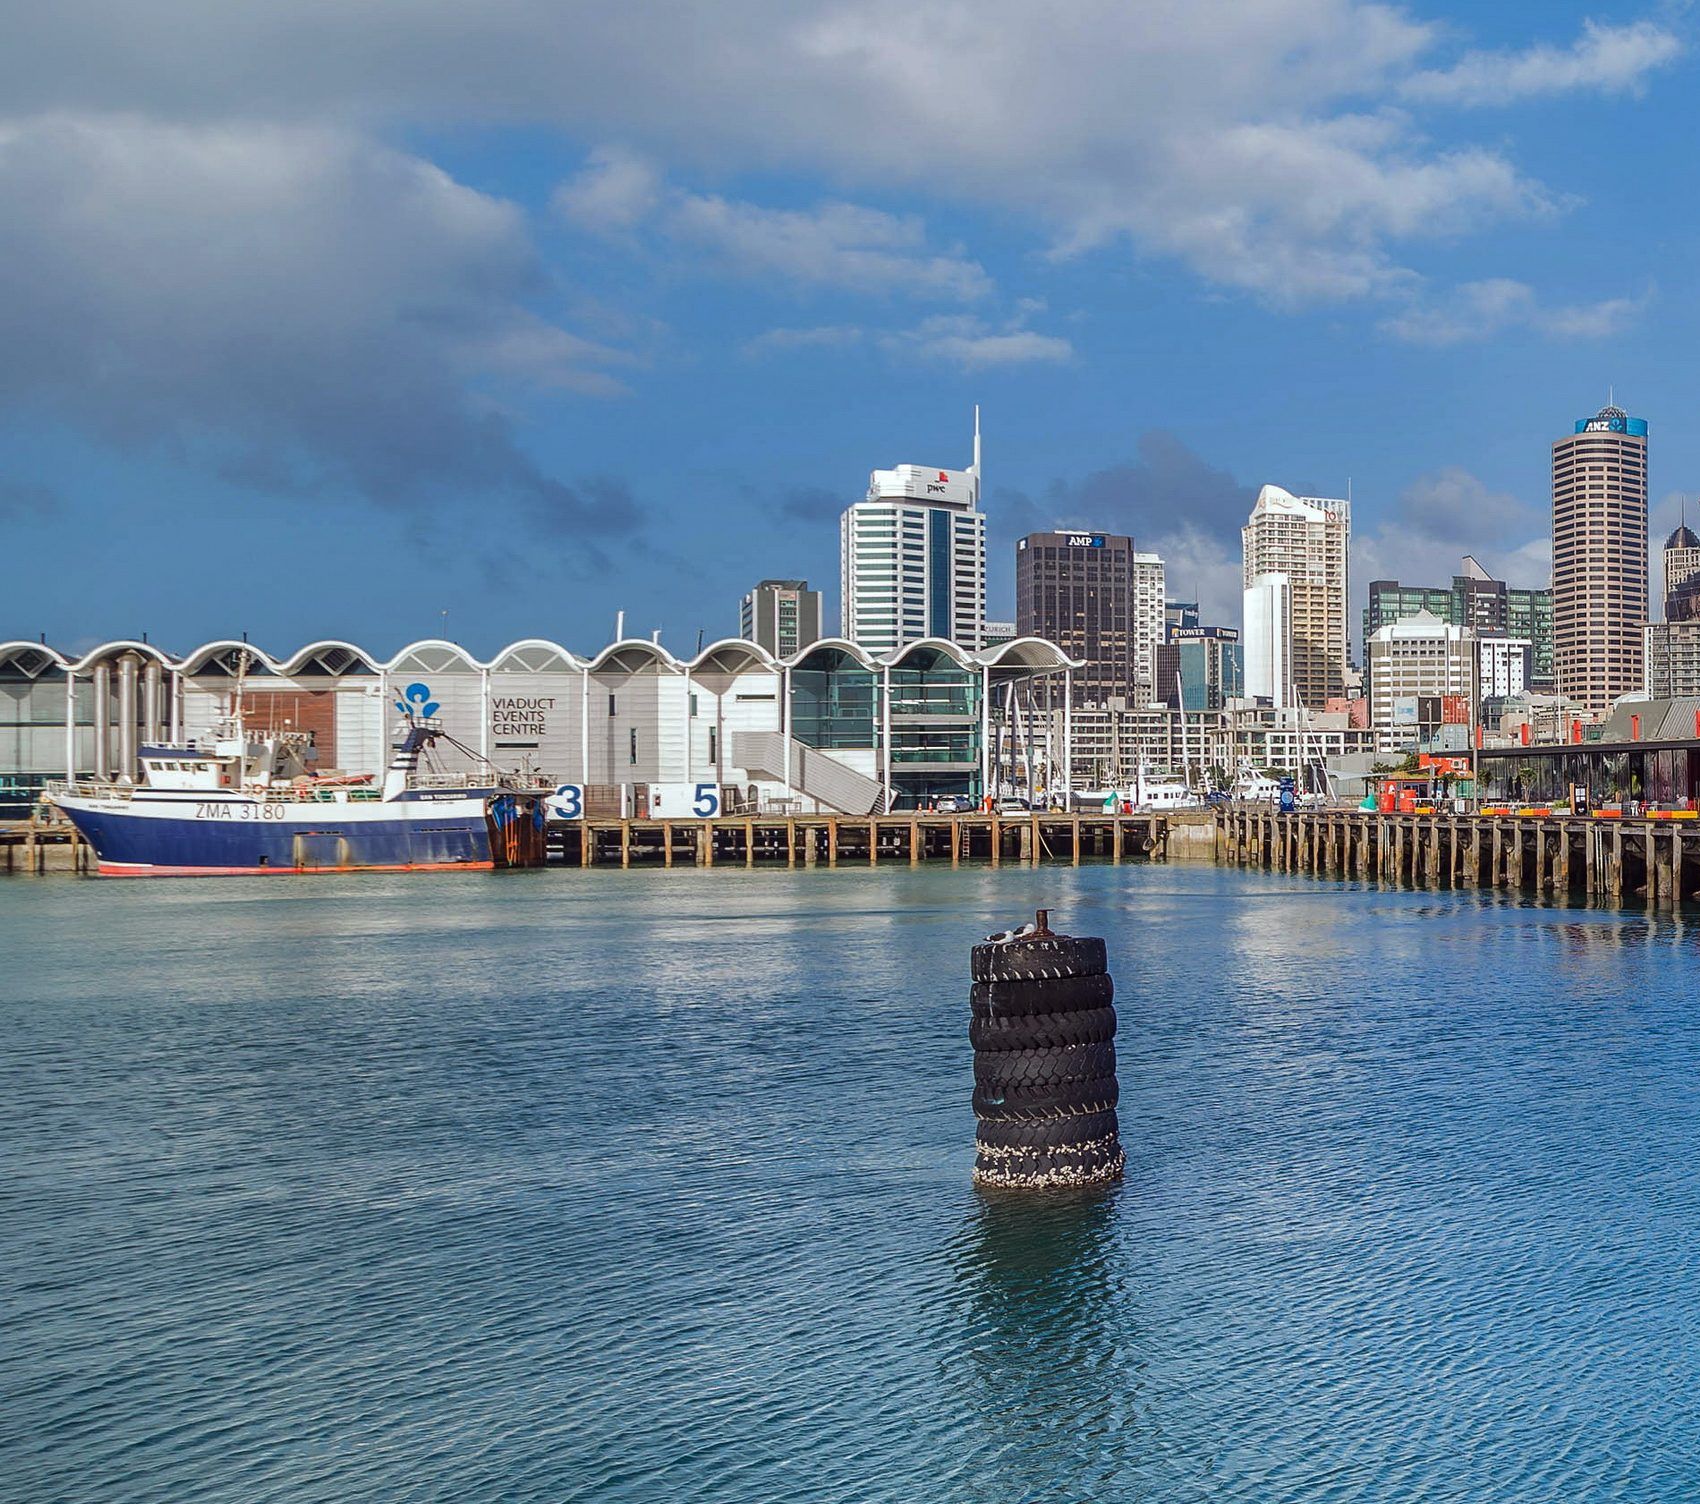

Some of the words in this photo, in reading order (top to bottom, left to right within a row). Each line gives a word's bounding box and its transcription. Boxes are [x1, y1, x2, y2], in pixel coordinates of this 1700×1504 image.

[1586, 421, 1609, 431] ANZ
[927, 484, 945, 494] pwc
[1069, 537, 1092, 546] AMP
[493, 698, 556, 709] VIADUCT
[493, 711, 545, 722] EVENTS
[493, 724, 546, 735] CENTRE
[555, 785, 581, 818] 3
[692, 784, 718, 817] 5
[196, 804, 232, 818] ZMA
[241, 805, 285, 819] 3180
